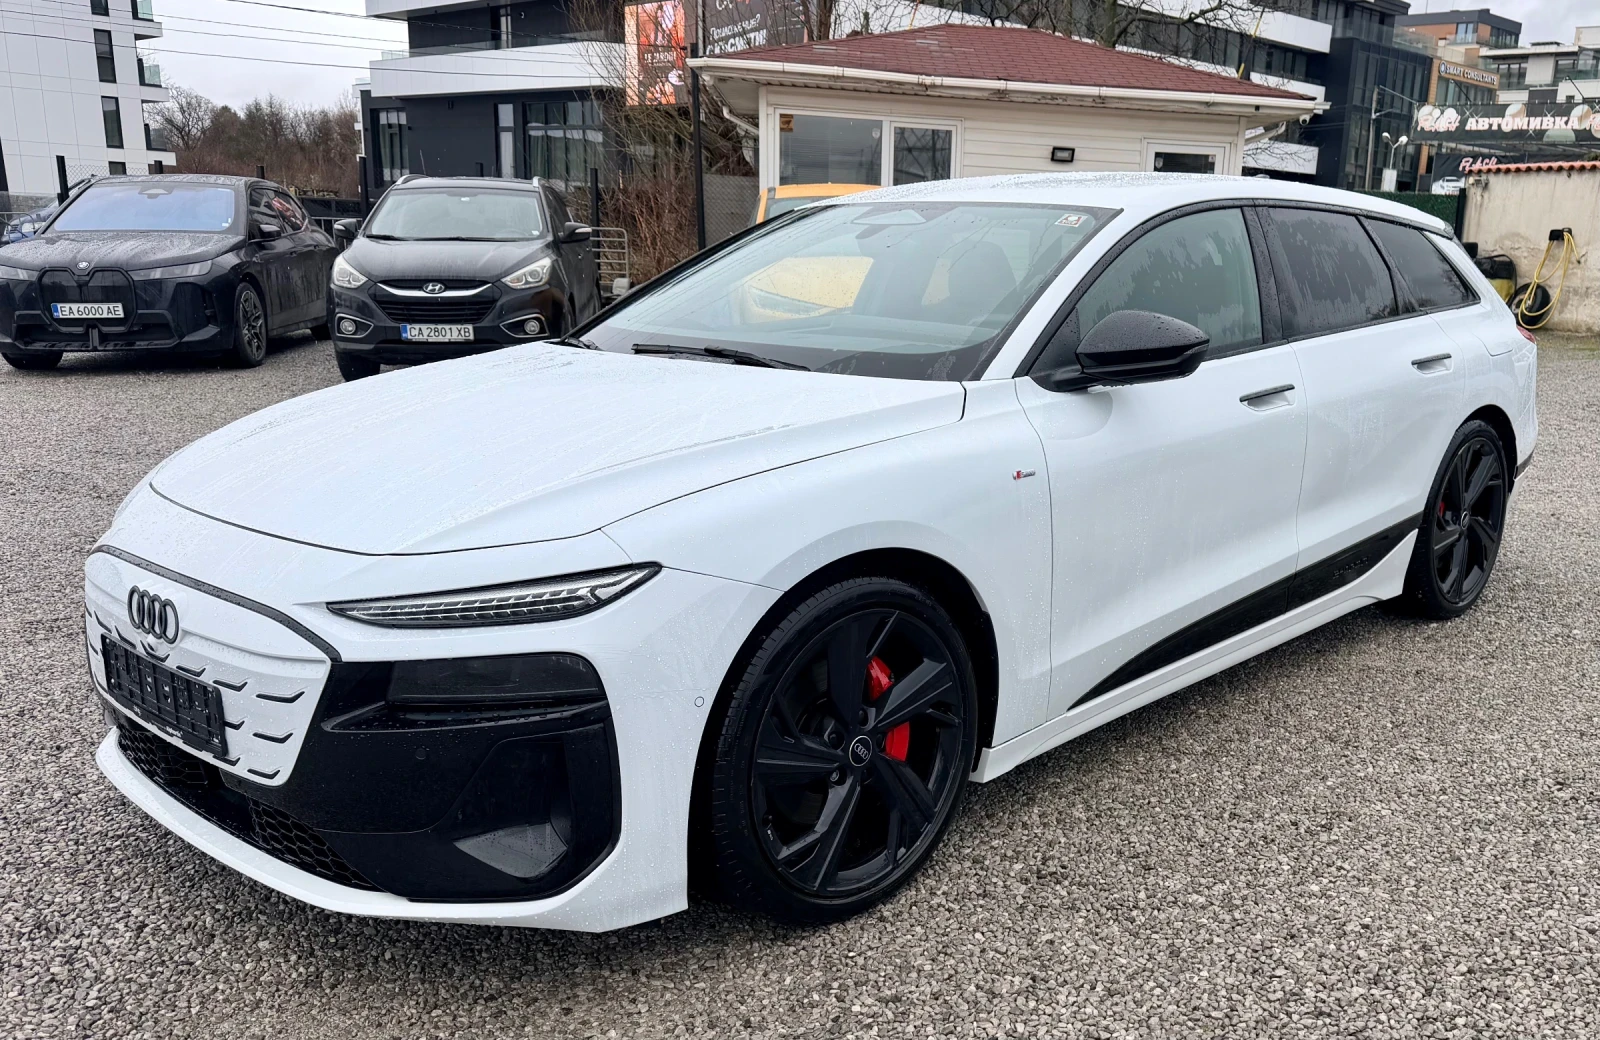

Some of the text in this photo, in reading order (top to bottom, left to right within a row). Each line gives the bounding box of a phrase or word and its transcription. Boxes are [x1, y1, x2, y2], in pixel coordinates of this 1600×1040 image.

[1446, 64, 1498, 85] SMART CONSULTANTS
[1465, 116, 1580, 131] АВТОМИВКА
[60, 305, 76, 317] EA
[77, 305, 104, 317] 6000
[106, 305, 122, 316] AE
[409, 326, 471, 338] CA 2801 XB
